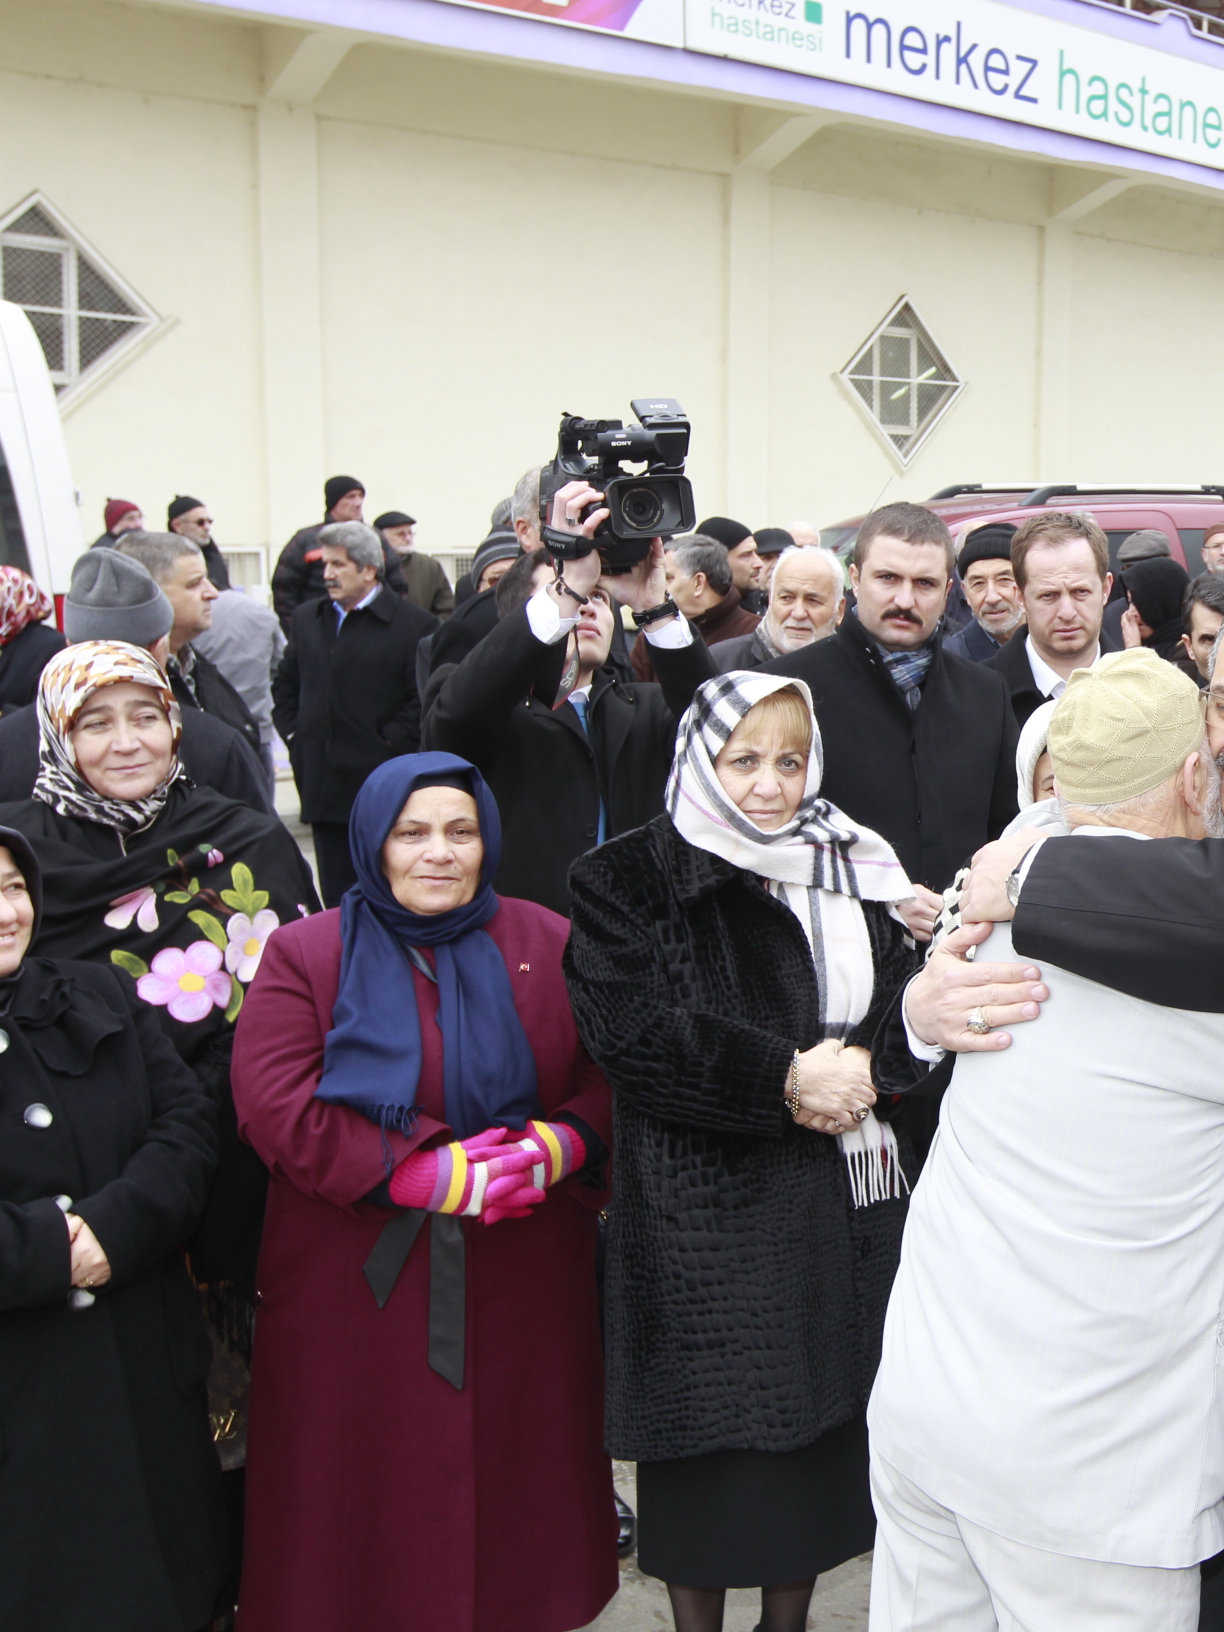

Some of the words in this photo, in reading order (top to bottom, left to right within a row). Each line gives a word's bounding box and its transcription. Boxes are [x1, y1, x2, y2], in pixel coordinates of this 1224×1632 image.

[711, 0, 797, 20] rkez
[711, 6, 823, 53] hastanesi
[845, 10, 1039, 104] merkez
[548, 540, 566, 550] SONY
